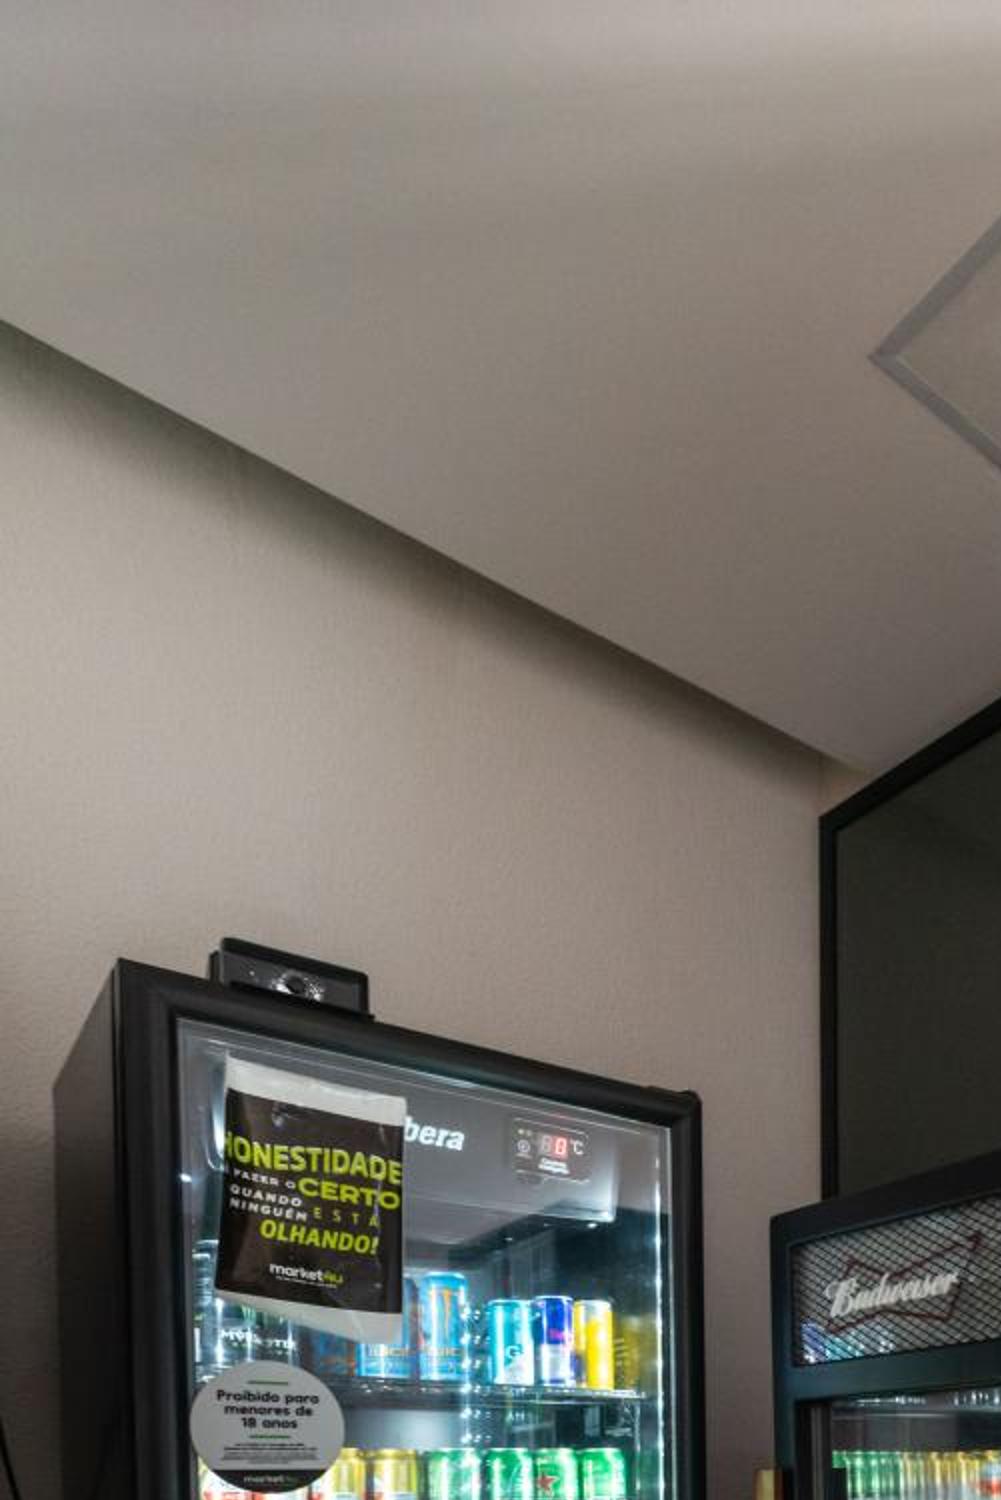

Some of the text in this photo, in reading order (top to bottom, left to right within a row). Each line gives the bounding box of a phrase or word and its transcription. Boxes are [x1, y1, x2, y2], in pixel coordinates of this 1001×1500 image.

[229, 1183, 303, 1208] QUANDO
[297, 1176, 401, 1210] CERTO
[228, 1197, 308, 1222] NINGUÉM
[259, 1218, 380, 1257] OLHANDO!
[824, 1272, 960, 1317] Budweiser
[216, 1389, 320, 1405] Proibido para
[224, 1404, 313, 1417] menores de
[241, 1418, 298, 1429] 18 anos
